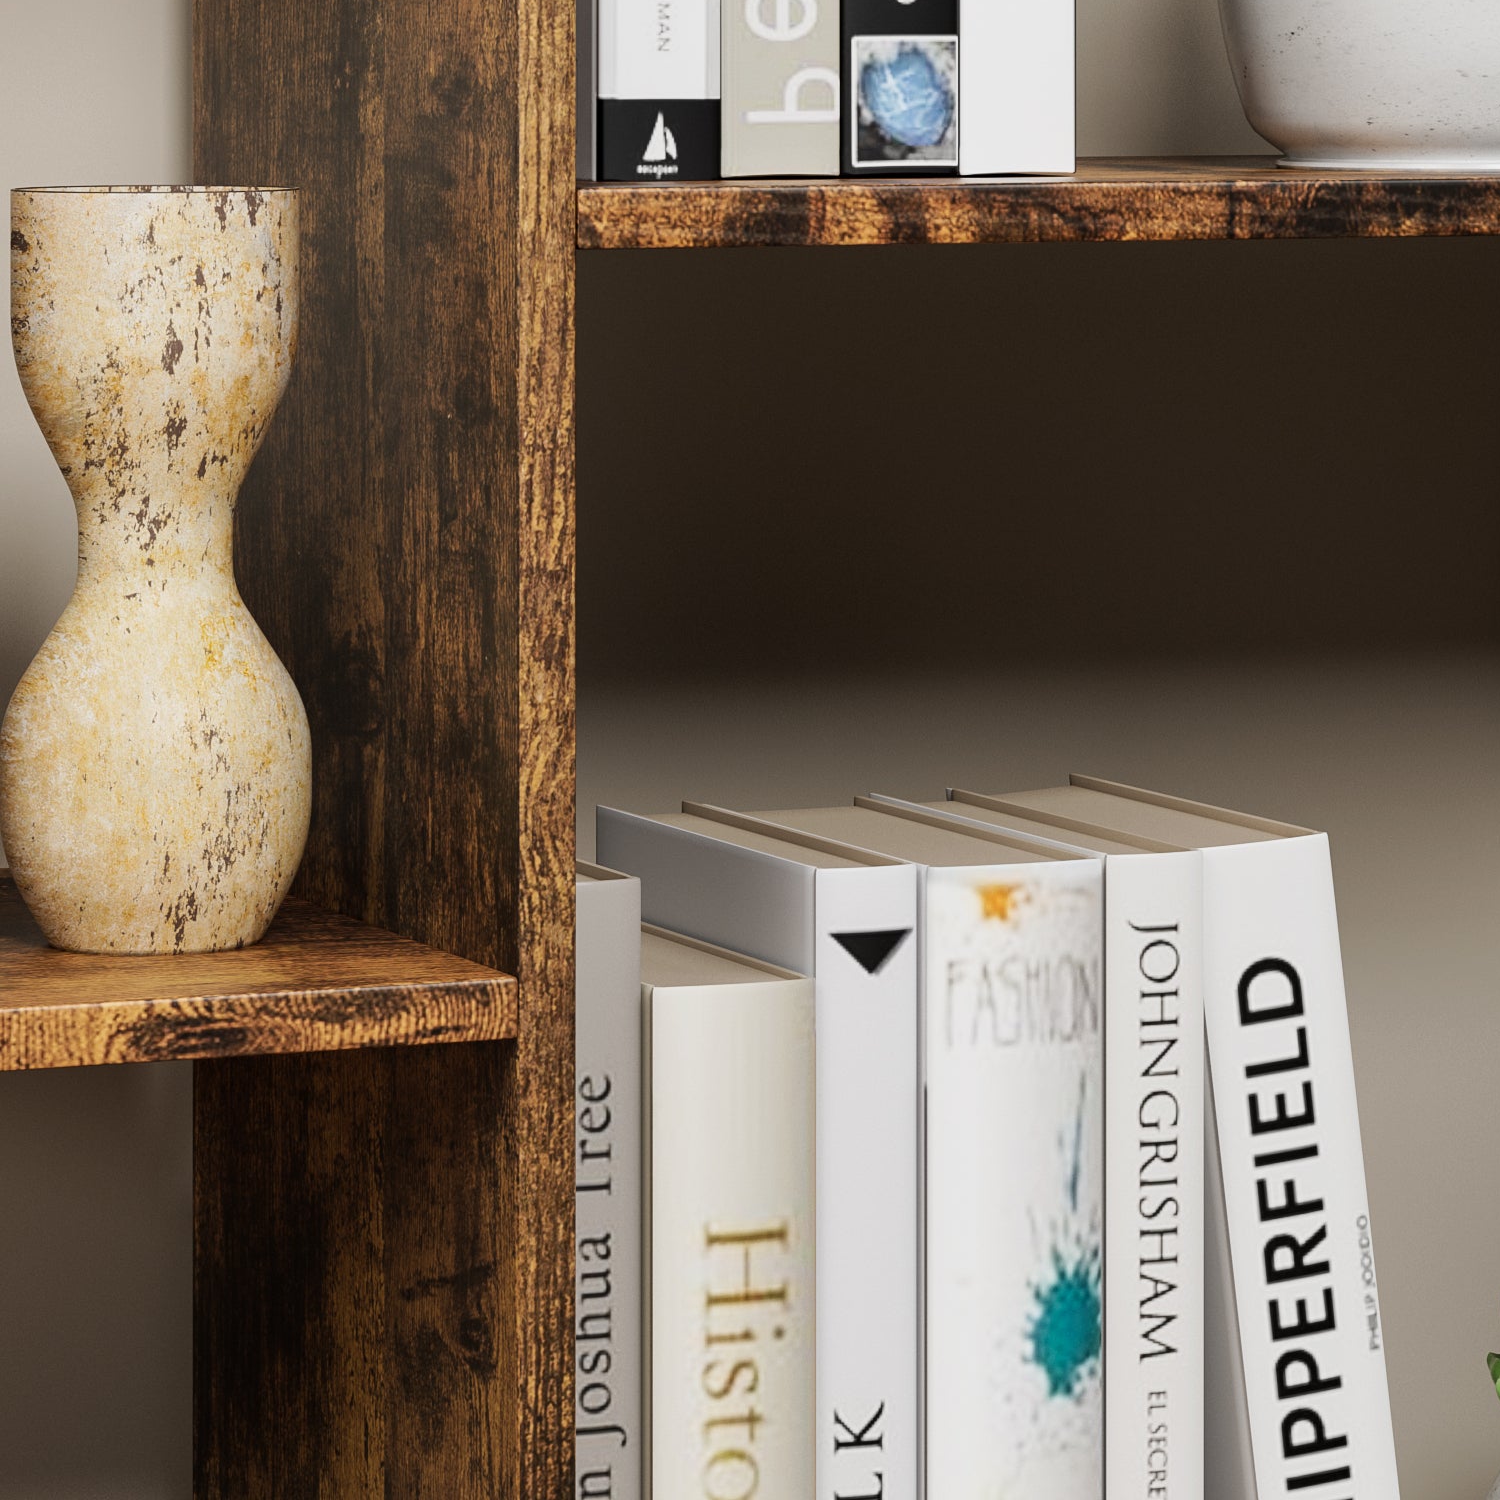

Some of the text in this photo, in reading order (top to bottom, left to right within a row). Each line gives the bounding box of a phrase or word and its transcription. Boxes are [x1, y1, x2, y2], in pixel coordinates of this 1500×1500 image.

[946, 954, 1099, 1047] FASHION
[1128, 919, 1180, 1363] JOHN GRISHAM
[1237, 956, 1353, 1500] IPPERFIELD
[576, 1231, 627, 1448] Joshua
[1147, 1390, 1168, 1416] EL
